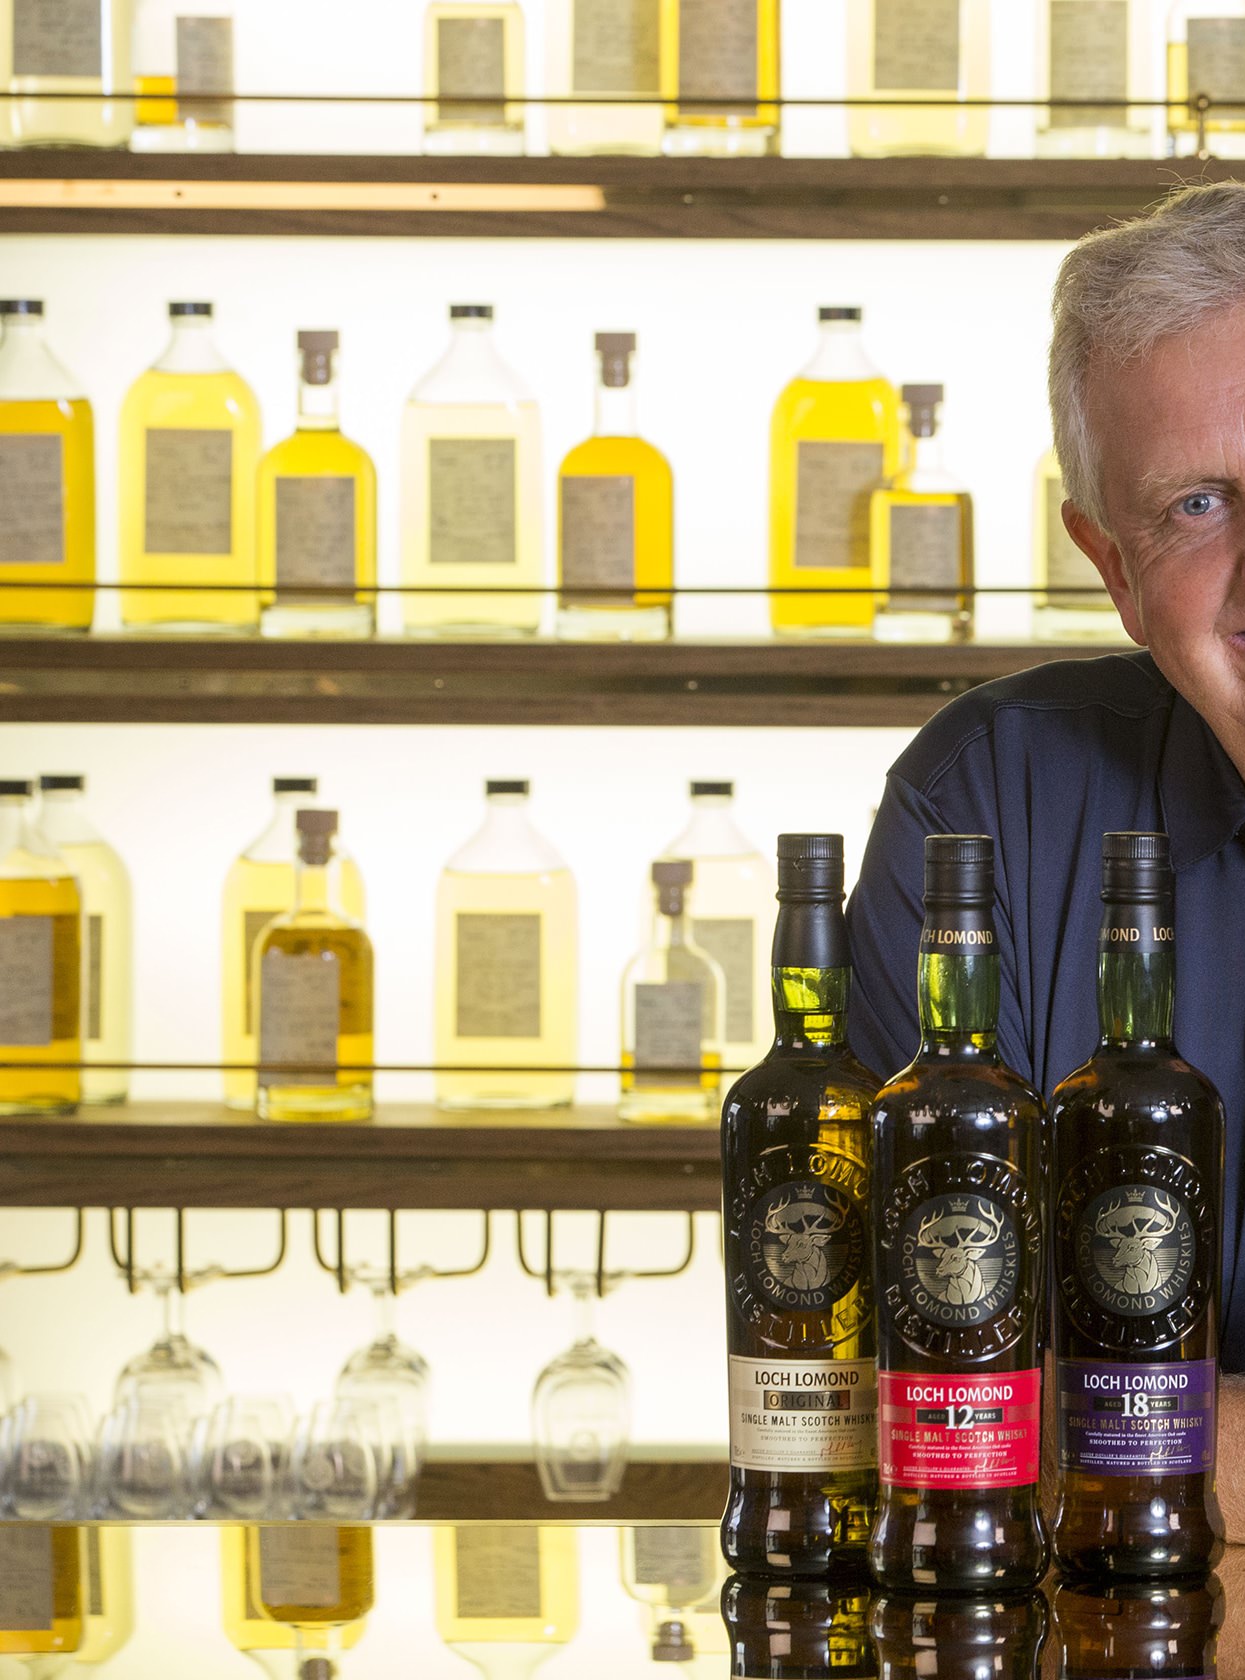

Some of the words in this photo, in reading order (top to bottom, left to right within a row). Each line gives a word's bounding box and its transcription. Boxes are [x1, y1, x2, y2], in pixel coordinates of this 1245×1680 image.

[937, 929, 993, 945] LOMOND
[1099, 927, 1140, 942] MOND
[751, 1219, 763, 1263] LOCH
[757, 1268, 824, 1305] LOMOND
[1087, 1273, 1155, 1309] LOMOND
[1159, 1221, 1191, 1300] WHISKIES
[903, 1233, 916, 1278] LOCH
[910, 1285, 980, 1321] LOMOND
[983, 1231, 1016, 1311] WHISKIES
[755, 1370, 790, 1386] LOCH
[795, 1371, 859, 1387] LOMOND
[1084, 1374, 1120, 1390] LOCH
[1125, 1374, 1188, 1390] LOMOND
[770, 1393, 843, 1408] ORIGINAL
[907, 1386, 944, 1402] LOCH
[948, 1386, 1013, 1403] LOMOND
[1121, 1392, 1149, 1417] 18
[1150, 1400, 1171, 1408] YEARS
[741, 1412, 767, 1425] SINGLE
[771, 1415, 797, 1426] MALT
[801, 1415, 840, 1426] SCOTCH
[844, 1413, 875, 1425] WHISKY
[945, 1404, 975, 1430] 12
[975, 1412, 996, 1420] YEARS
[1068, 1416, 1096, 1429] SINGLE
[1100, 1419, 1127, 1430] MALT
[1131, 1419, 1170, 1431] SCOTCH
[1173, 1416, 1203, 1429] WHISKY
[891, 1429, 920, 1442] SINGLE
[924, 1431, 950, 1443] MALT
[955, 1431, 995, 1443] SCOTCH
[997, 1428, 1027, 1442] WHISKY
[913, 1451, 951, 1459] SMOOTHED
[964, 1451, 1008, 1459] PERFECTION
